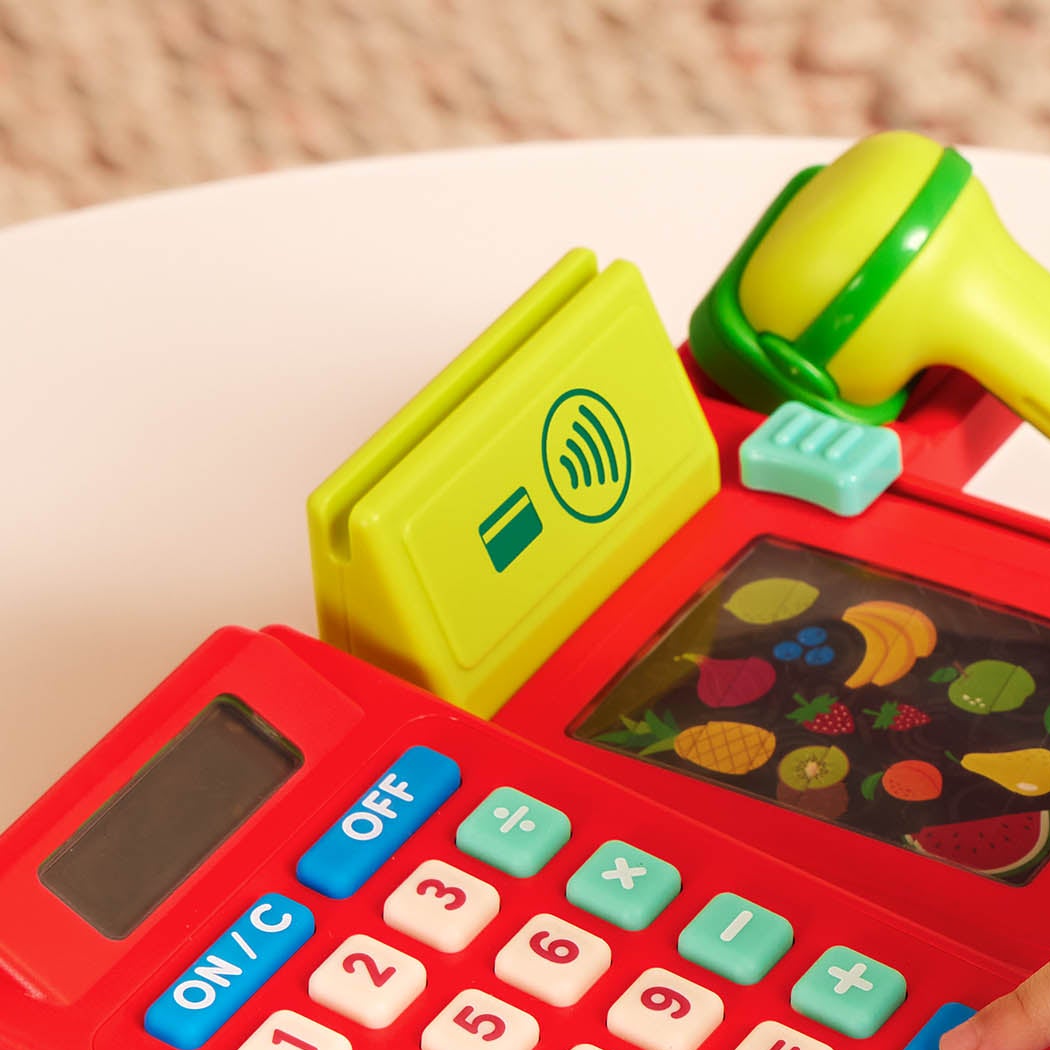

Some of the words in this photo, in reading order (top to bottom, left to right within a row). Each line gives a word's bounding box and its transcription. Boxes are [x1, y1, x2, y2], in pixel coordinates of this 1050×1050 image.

[341, 773, 414, 841] OFF
[415, 878, 467, 912] 3
[173, 955, 243, 1010] ON
[249, 903, 293, 933] C
[528, 930, 580, 965] 6
[341, 952, 397, 989] 2
[639, 985, 692, 1020] 9
[452, 1005, 507, 1042] 5
